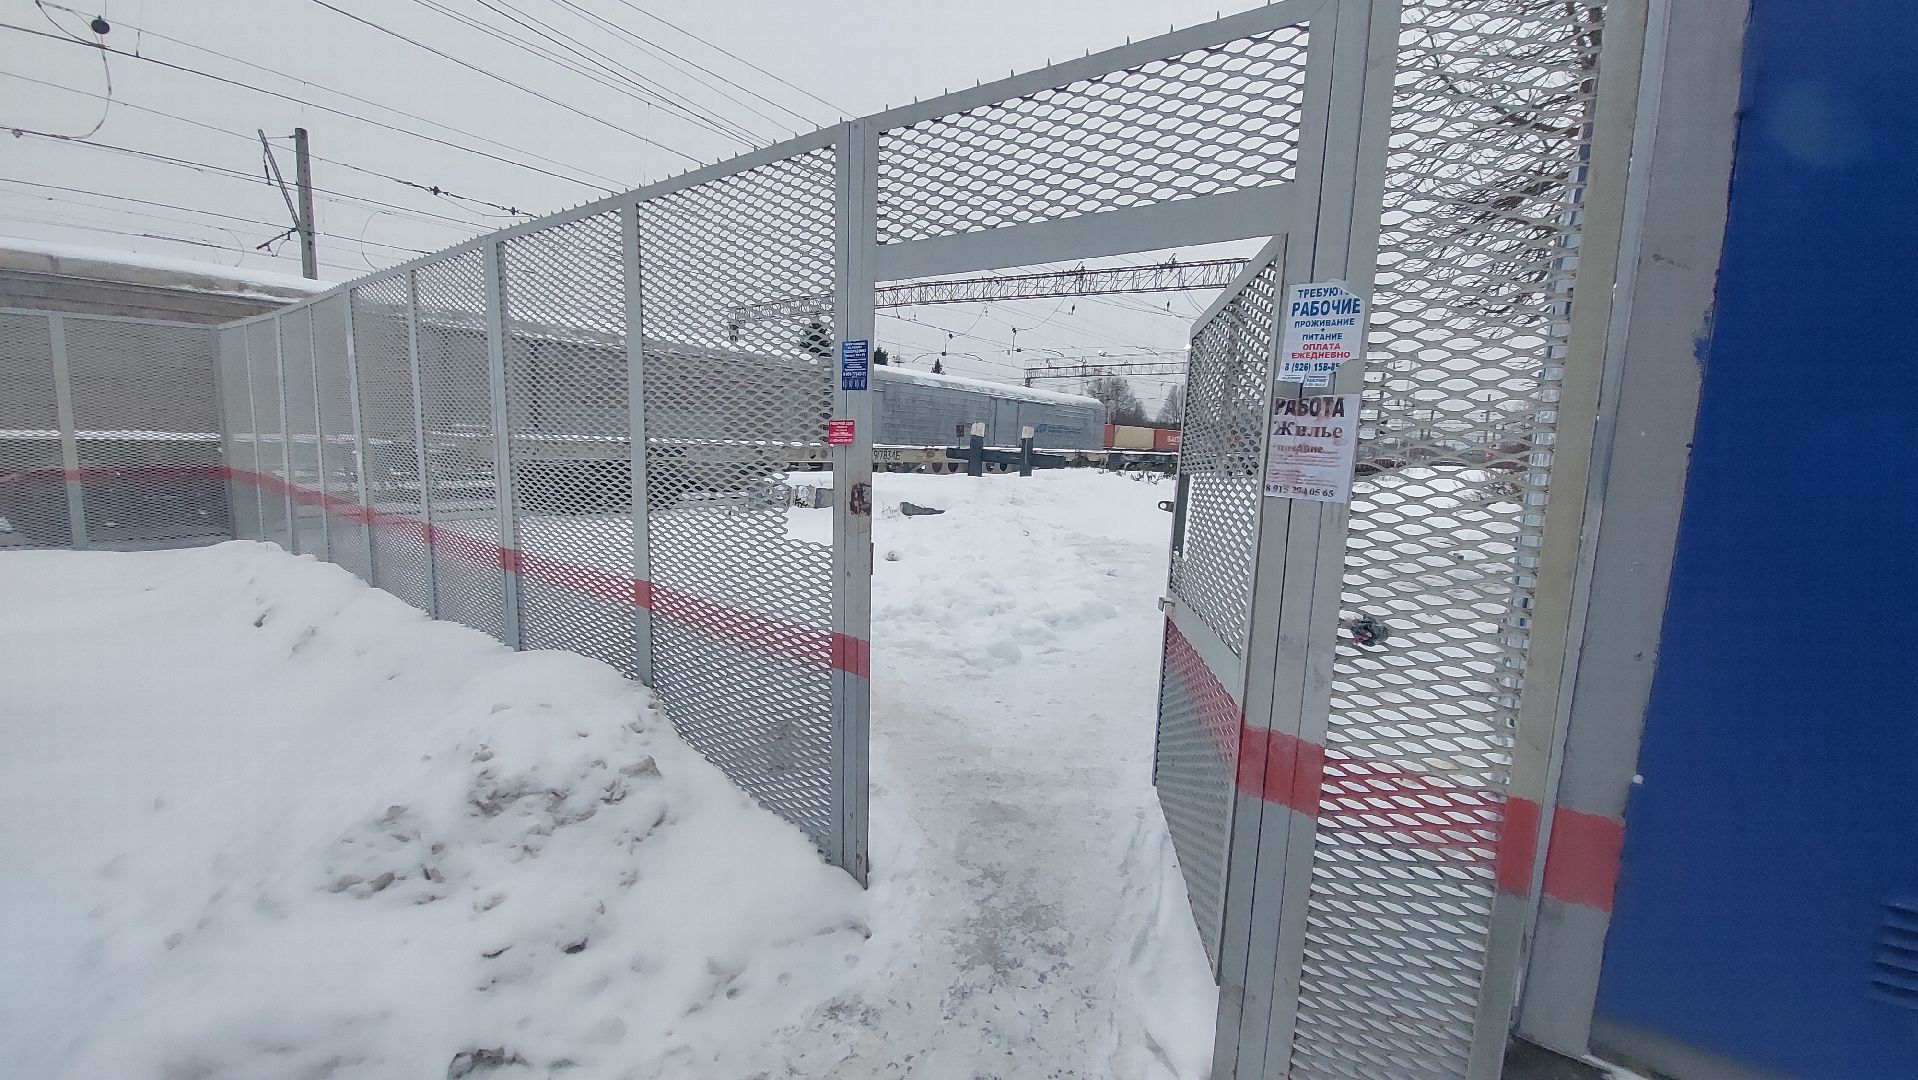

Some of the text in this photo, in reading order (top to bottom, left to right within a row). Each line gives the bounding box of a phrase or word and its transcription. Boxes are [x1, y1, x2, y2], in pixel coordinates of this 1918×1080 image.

[1292, 298, 1360, 317] РАБОЧИЕ
[1294, 318, 1355, 328] ПРОЖИВАНИЕ
[1302, 333, 1343, 341] ПИТАНИЕ
[1303, 343, 1340, 351] ОПЛАТА
[1291, 352, 1351, 360] ЕЖЕДНЕВНО
[1274, 397, 1345, 417] РАБОТА
